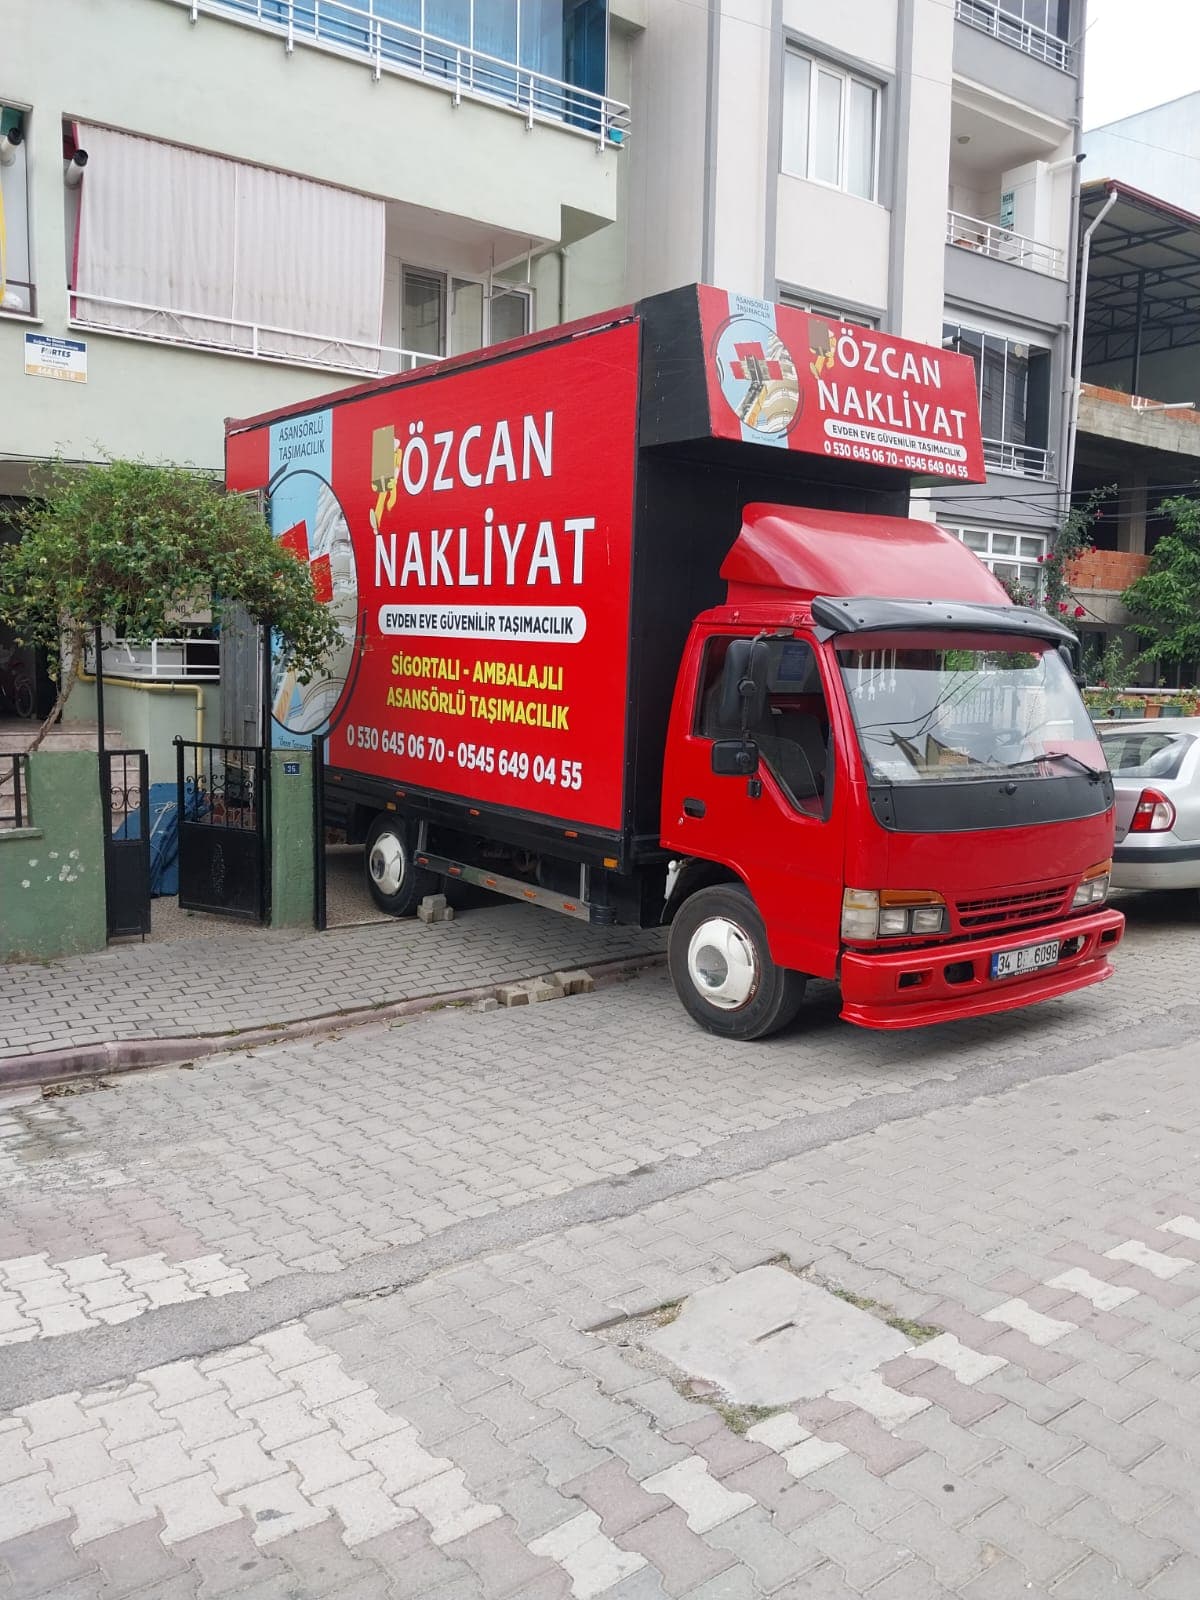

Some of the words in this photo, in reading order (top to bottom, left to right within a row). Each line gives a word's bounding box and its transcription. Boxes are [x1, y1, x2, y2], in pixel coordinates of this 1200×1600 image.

[837, 327, 941, 389] ÖZCAN
[278, 416, 323, 442] ASANSÖRLÜ
[817, 379, 966, 439] NAKLİYAT
[279, 440, 325, 461] TAŞIMACILIK
[402, 411, 554, 496] ÖZCAN
[824, 440, 831, 454] 0
[833, 441, 851, 457] 530
[852, 445, 871, 461] 645
[872, 449, 885, 463] 06
[886, 451, 898, 465] 70
[904, 454, 927, 471] 0545
[927, 459, 944, 474] 649
[945, 463, 957, 475] 04
[957, 465, 968, 478] 55
[832, 424, 859, 439] EVDEN
[860, 429, 876, 441] EVE
[877, 432, 916, 449] GÜVENİLİR
[917, 440, 961, 458] TAŞIMACILIK
[374, 507, 596, 587] NAKLİYAT
[386, 613, 417, 629] EVDEN
[419, 614, 438, 629] EVE
[440, 612, 496, 632] GÜVENİLİR
[498, 616, 574, 637] TAŞIMACILIK
[391, 651, 460, 681] SİGORTALI
[473, 661, 564, 691] AMBALAJLI
[386, 686, 466, 716] ASANSÖRLÜ
[470, 696, 570, 730] TAŞIMACILIK
[346, 724, 355, 746] 0
[357, 726, 379, 751] 530
[381, 729, 405, 755] 645
[407, 734, 424, 760] 06
[427, 737, 445, 763] 70
[457, 743, 495, 774] 0545
[498, 750, 529, 780] 649
[533, 756, 556, 785] 04
[561, 760, 583, 790] 55
[998, 954, 1010, 972] 34
[1034, 943, 1058, 964] 6098
